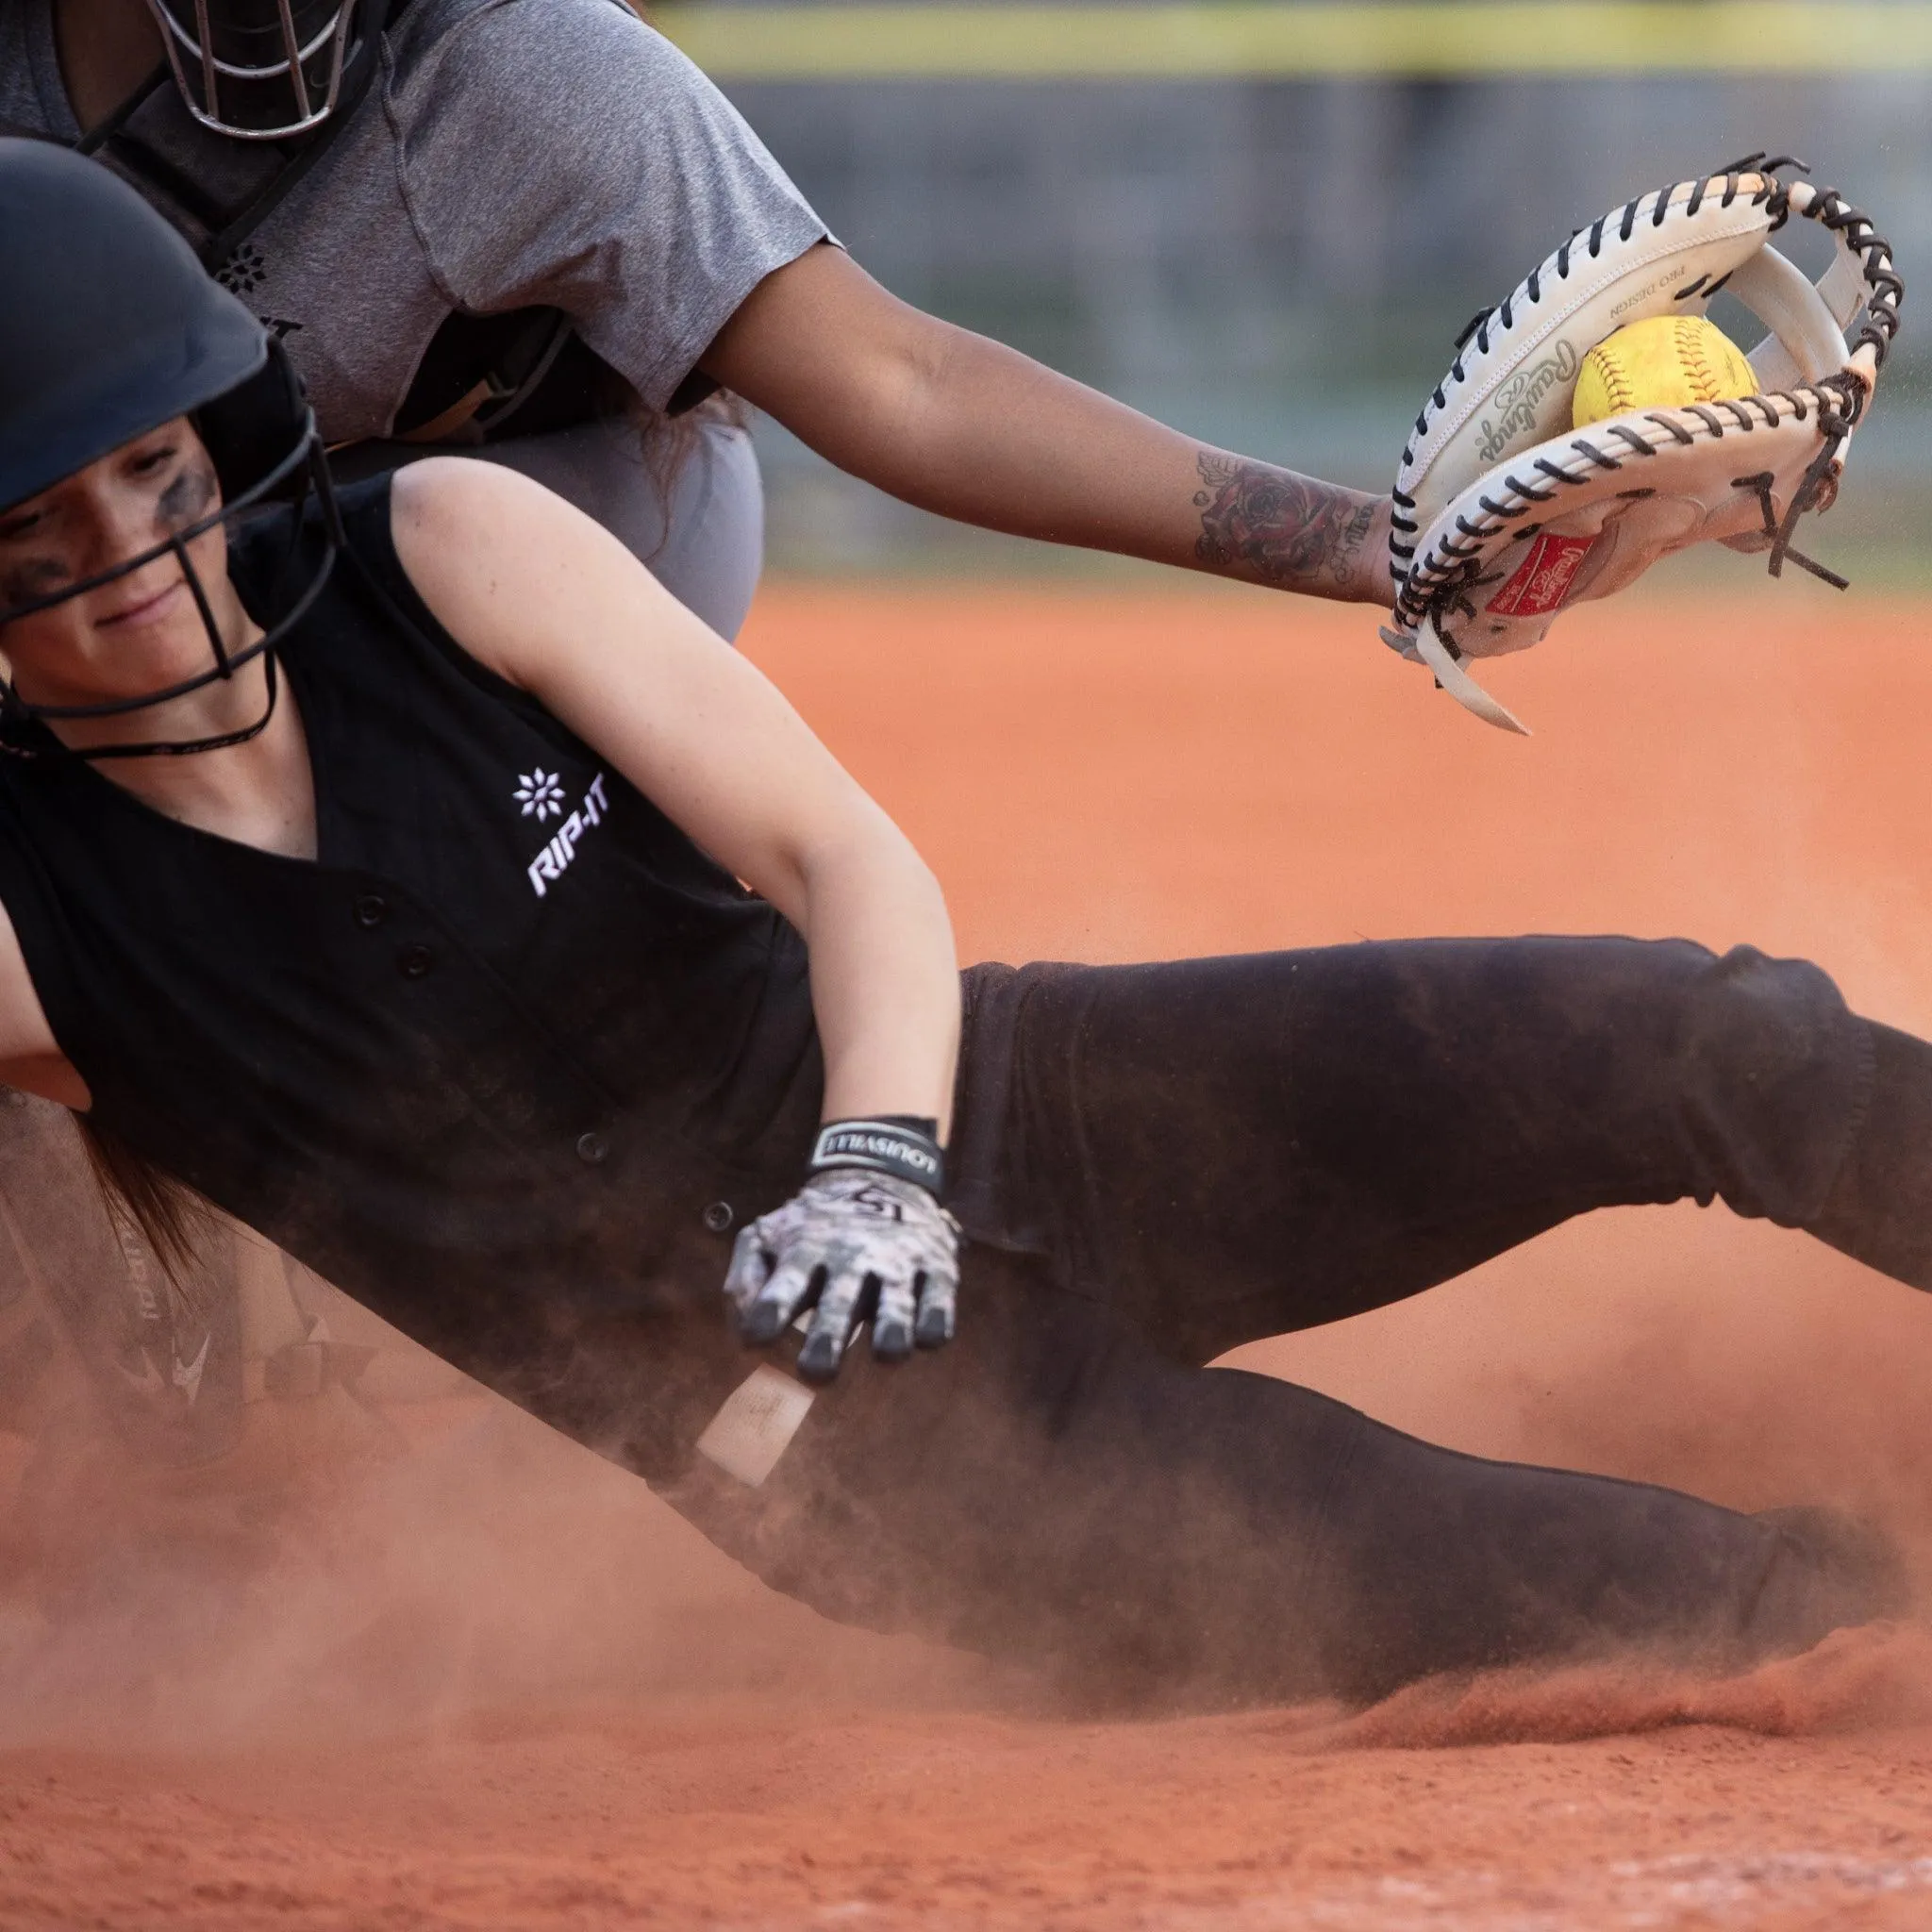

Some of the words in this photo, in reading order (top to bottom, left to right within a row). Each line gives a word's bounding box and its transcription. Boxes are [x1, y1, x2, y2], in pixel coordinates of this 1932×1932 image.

[1609, 283, 1656, 319] DESIGN
[1658, 265, 1686, 288] PRO
[1478, 339, 1576, 462] Rawlings
[526, 772, 608, 898] RIP-IT
